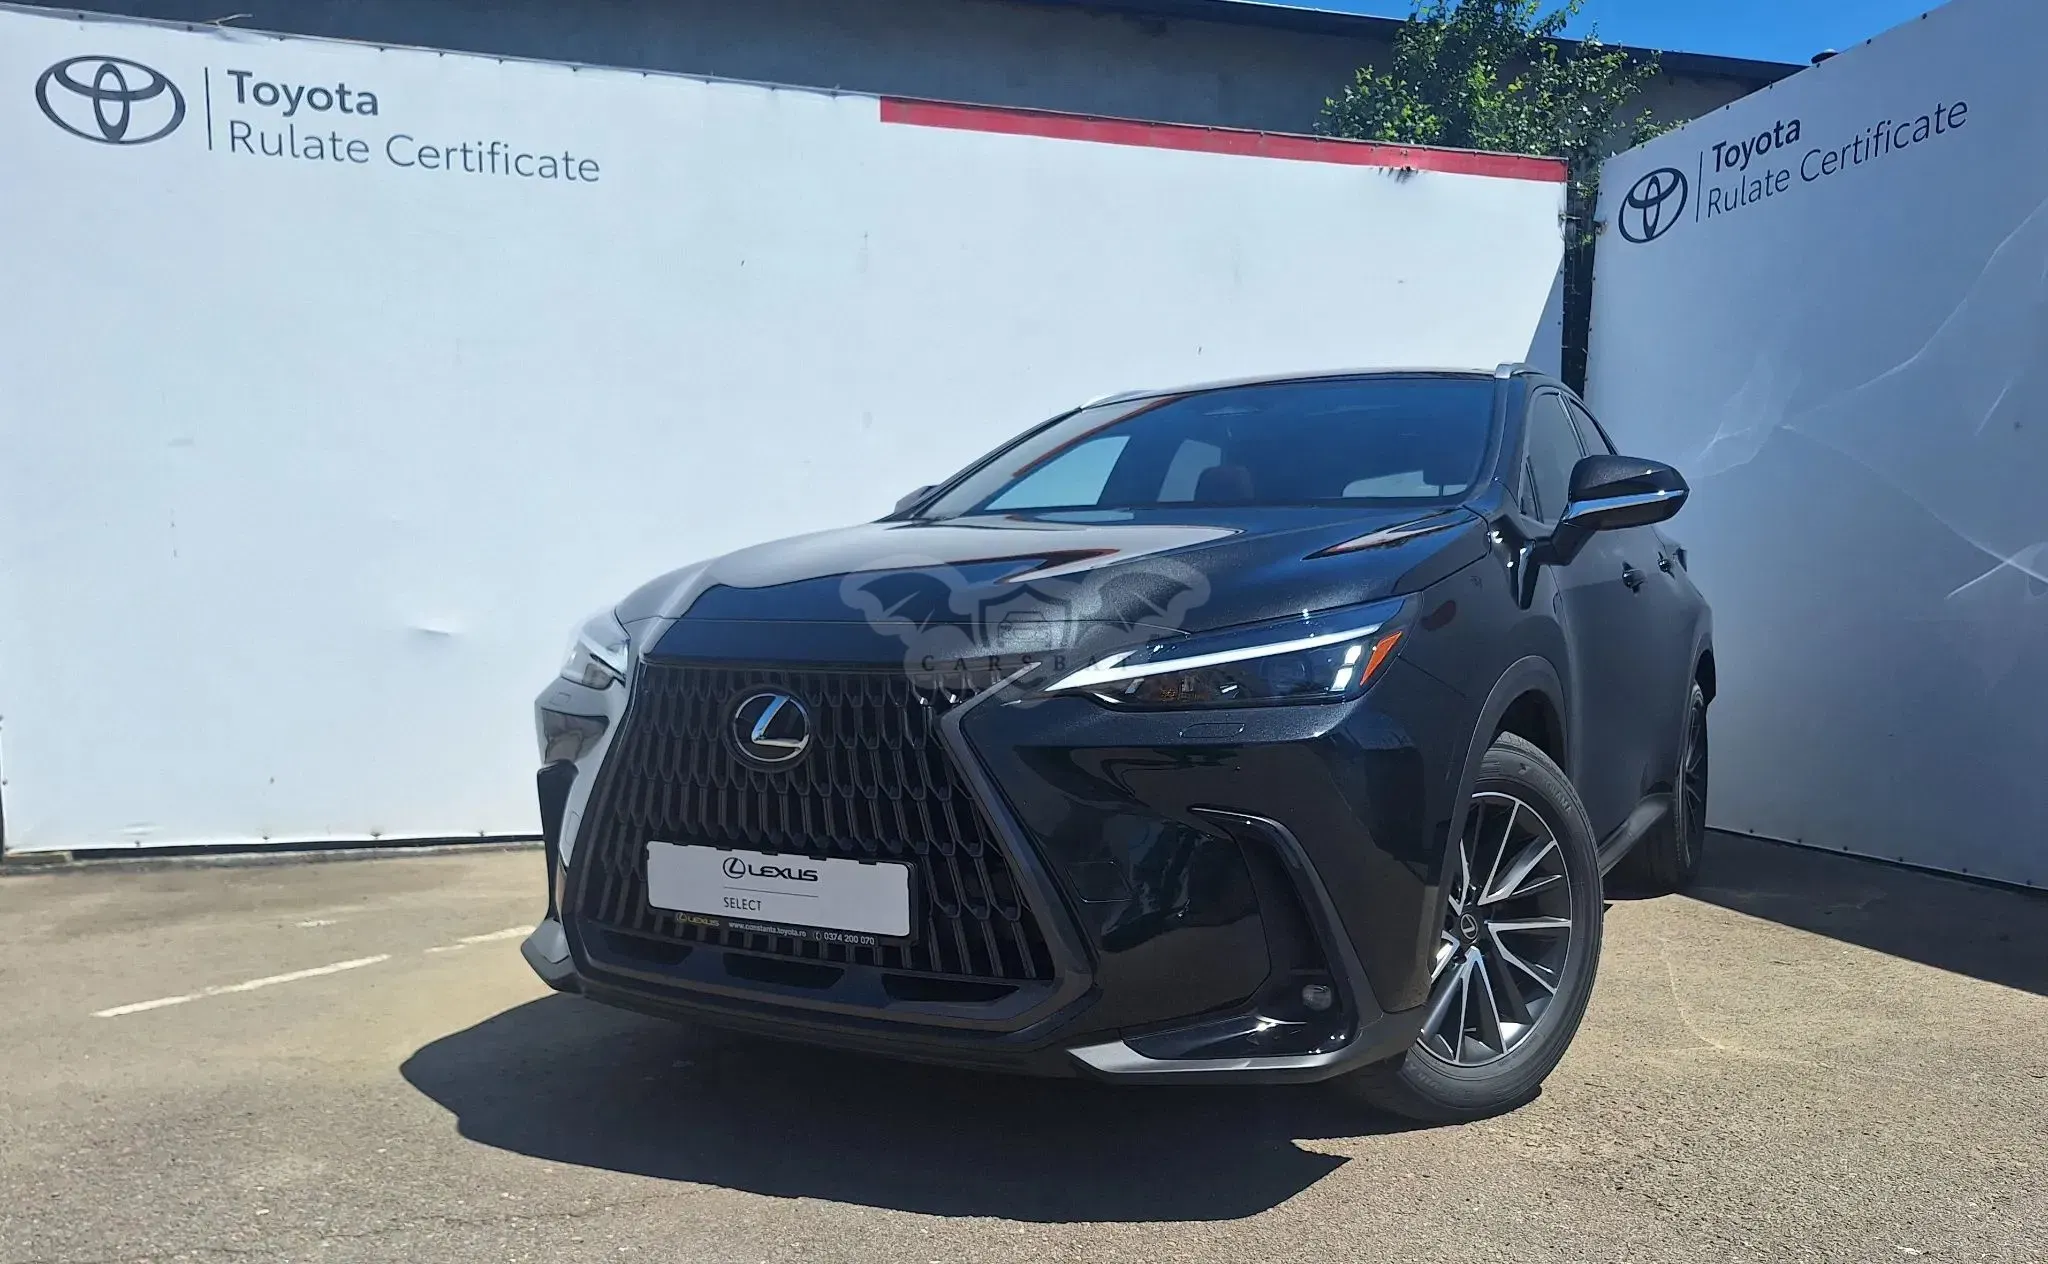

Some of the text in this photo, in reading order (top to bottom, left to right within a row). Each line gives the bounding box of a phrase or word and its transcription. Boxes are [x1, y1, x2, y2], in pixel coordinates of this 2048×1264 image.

[227, 69, 379, 117] Toyota
[229, 120, 601, 183] Rulate Certificate
[1707, 101, 1968, 218] Rulate Certificate
[1711, 119, 1801, 173] Toyota
[748, 864, 819, 882] LEXUS
[723, 896, 762, 911] SELECT
[687, 915, 721, 927] LEXUS
[823, 931, 843, 942] 0374
[844, 934, 859, 944] 200
[860, 936, 875, 946] 070
